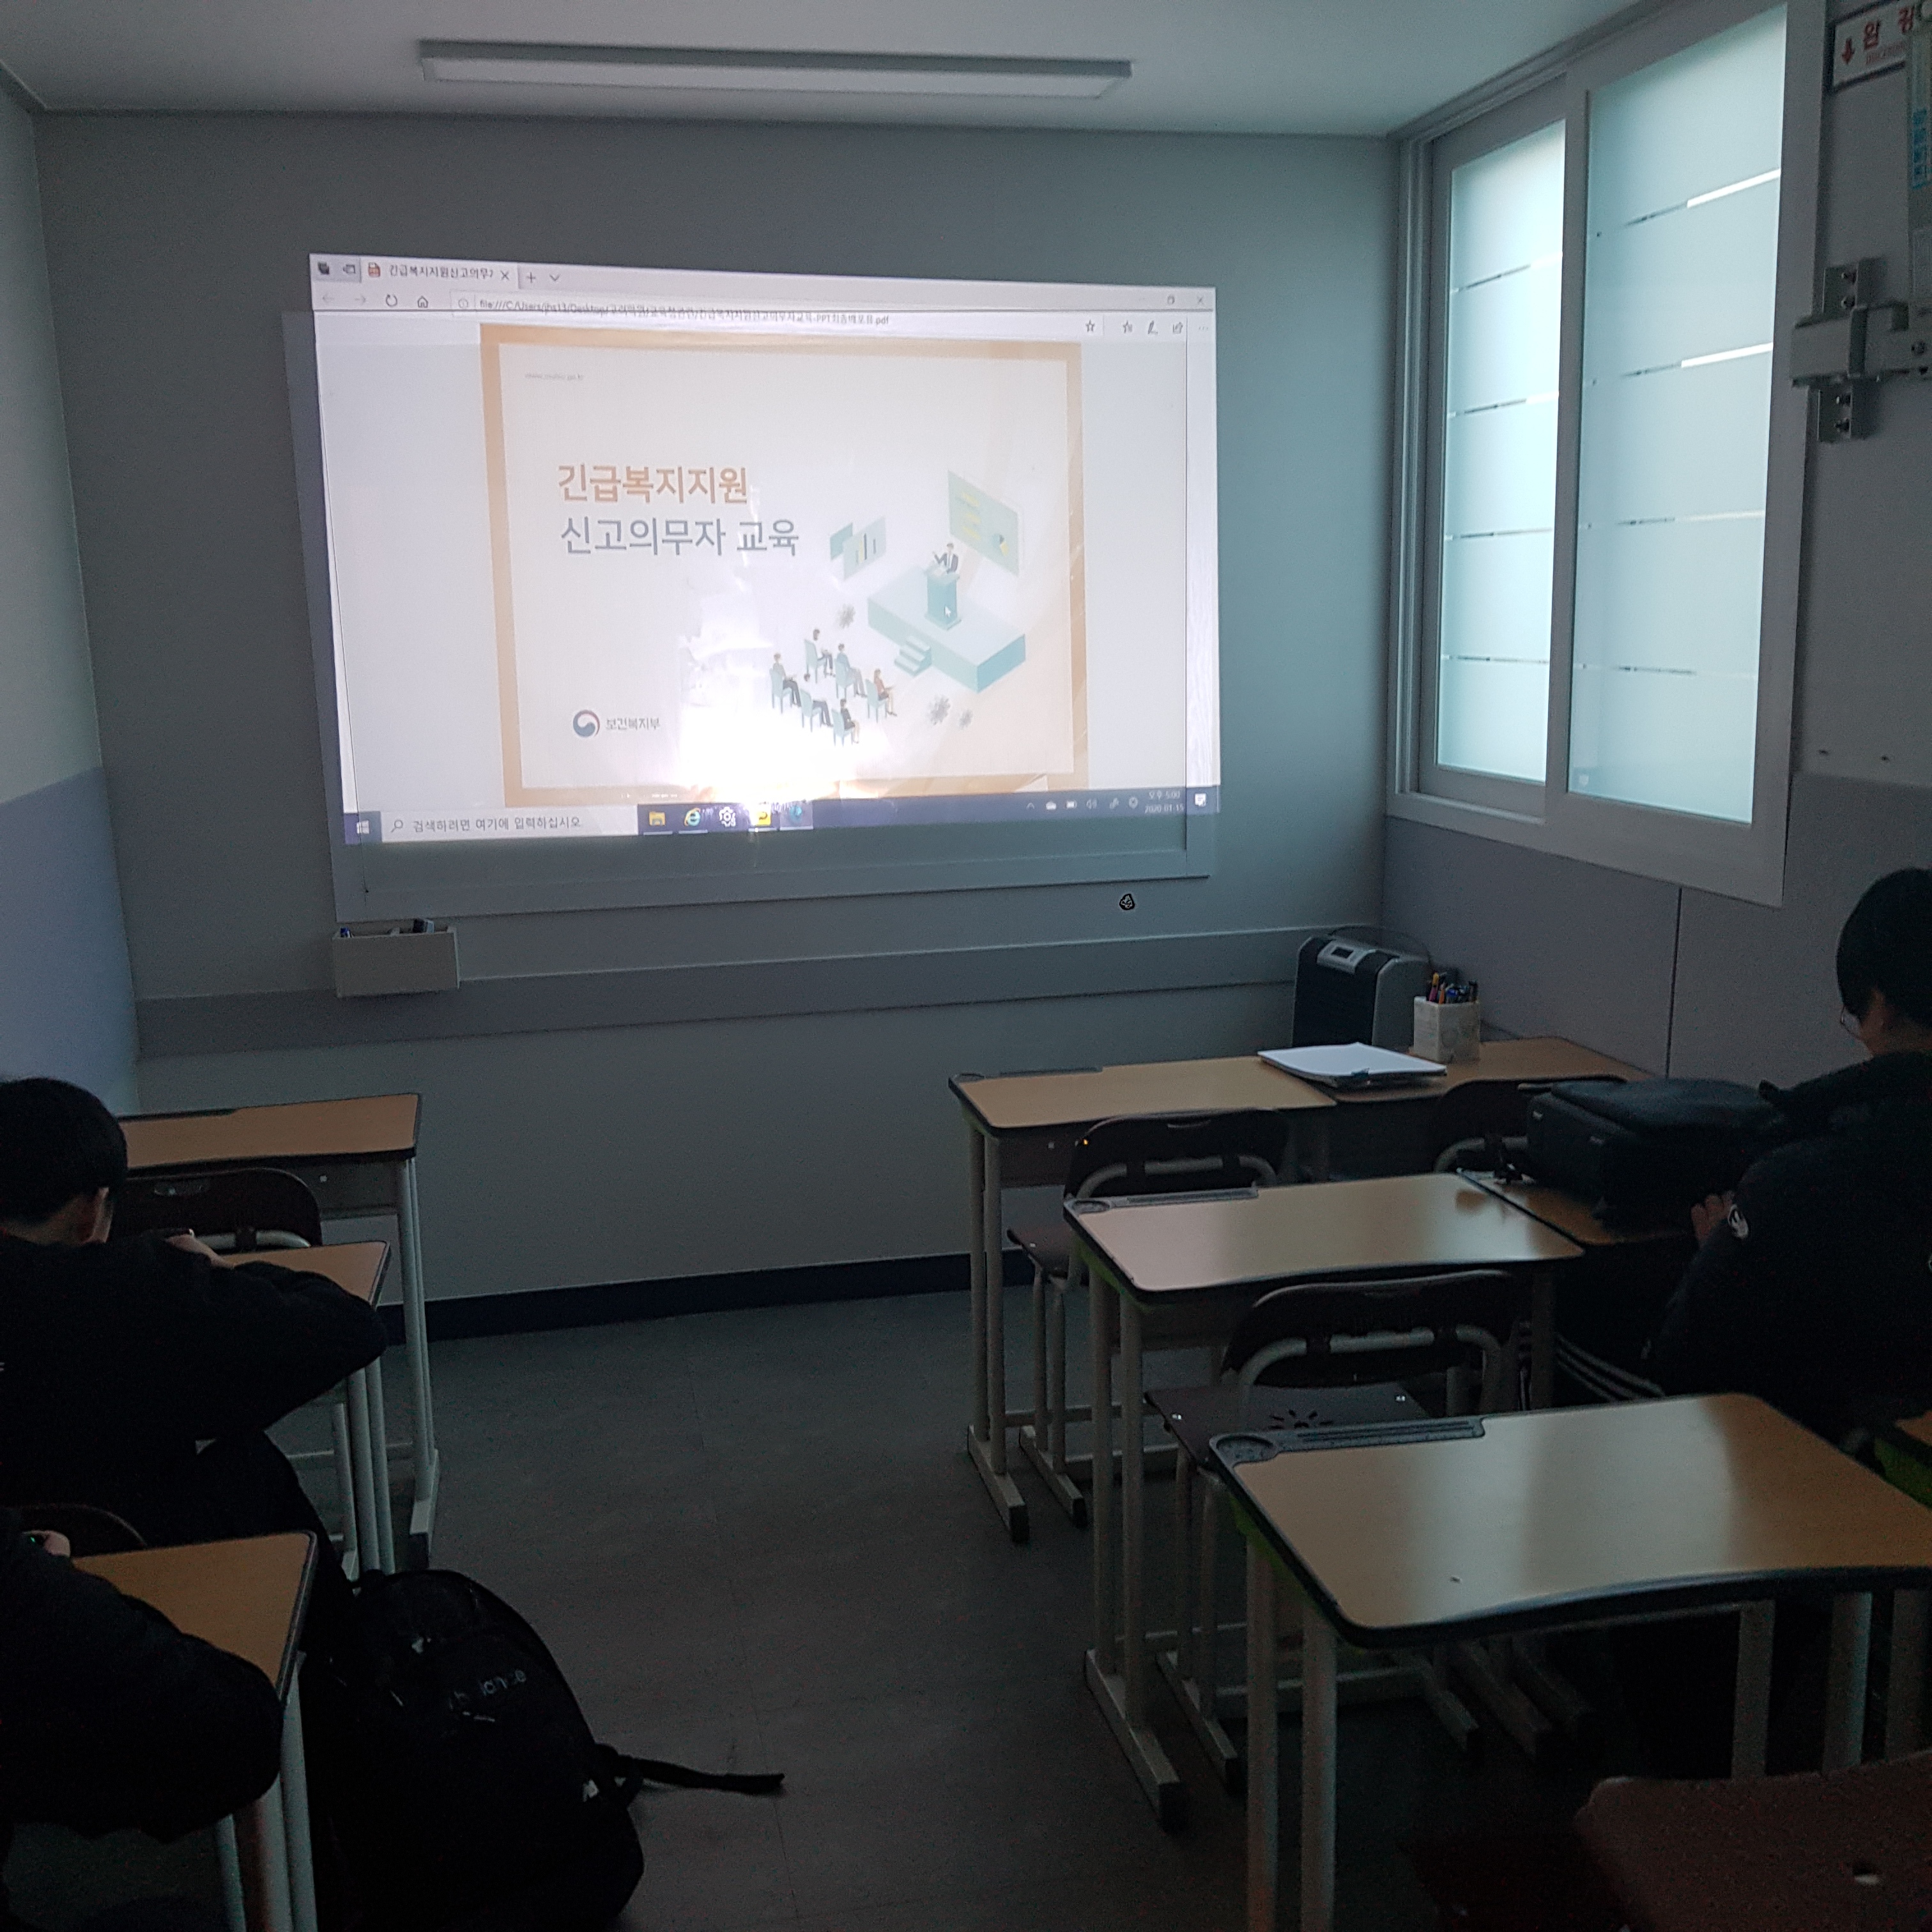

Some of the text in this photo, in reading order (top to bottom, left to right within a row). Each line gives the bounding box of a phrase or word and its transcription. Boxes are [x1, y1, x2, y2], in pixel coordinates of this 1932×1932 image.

[558, 463, 747, 504] 긴급복지지원
[560, 516, 799, 556] 신고의무자 교육
[606, 717, 661, 730] 보건복지부
[413, 818, 470, 833] 검색하려면
[475, 817, 509, 832] 여기에
